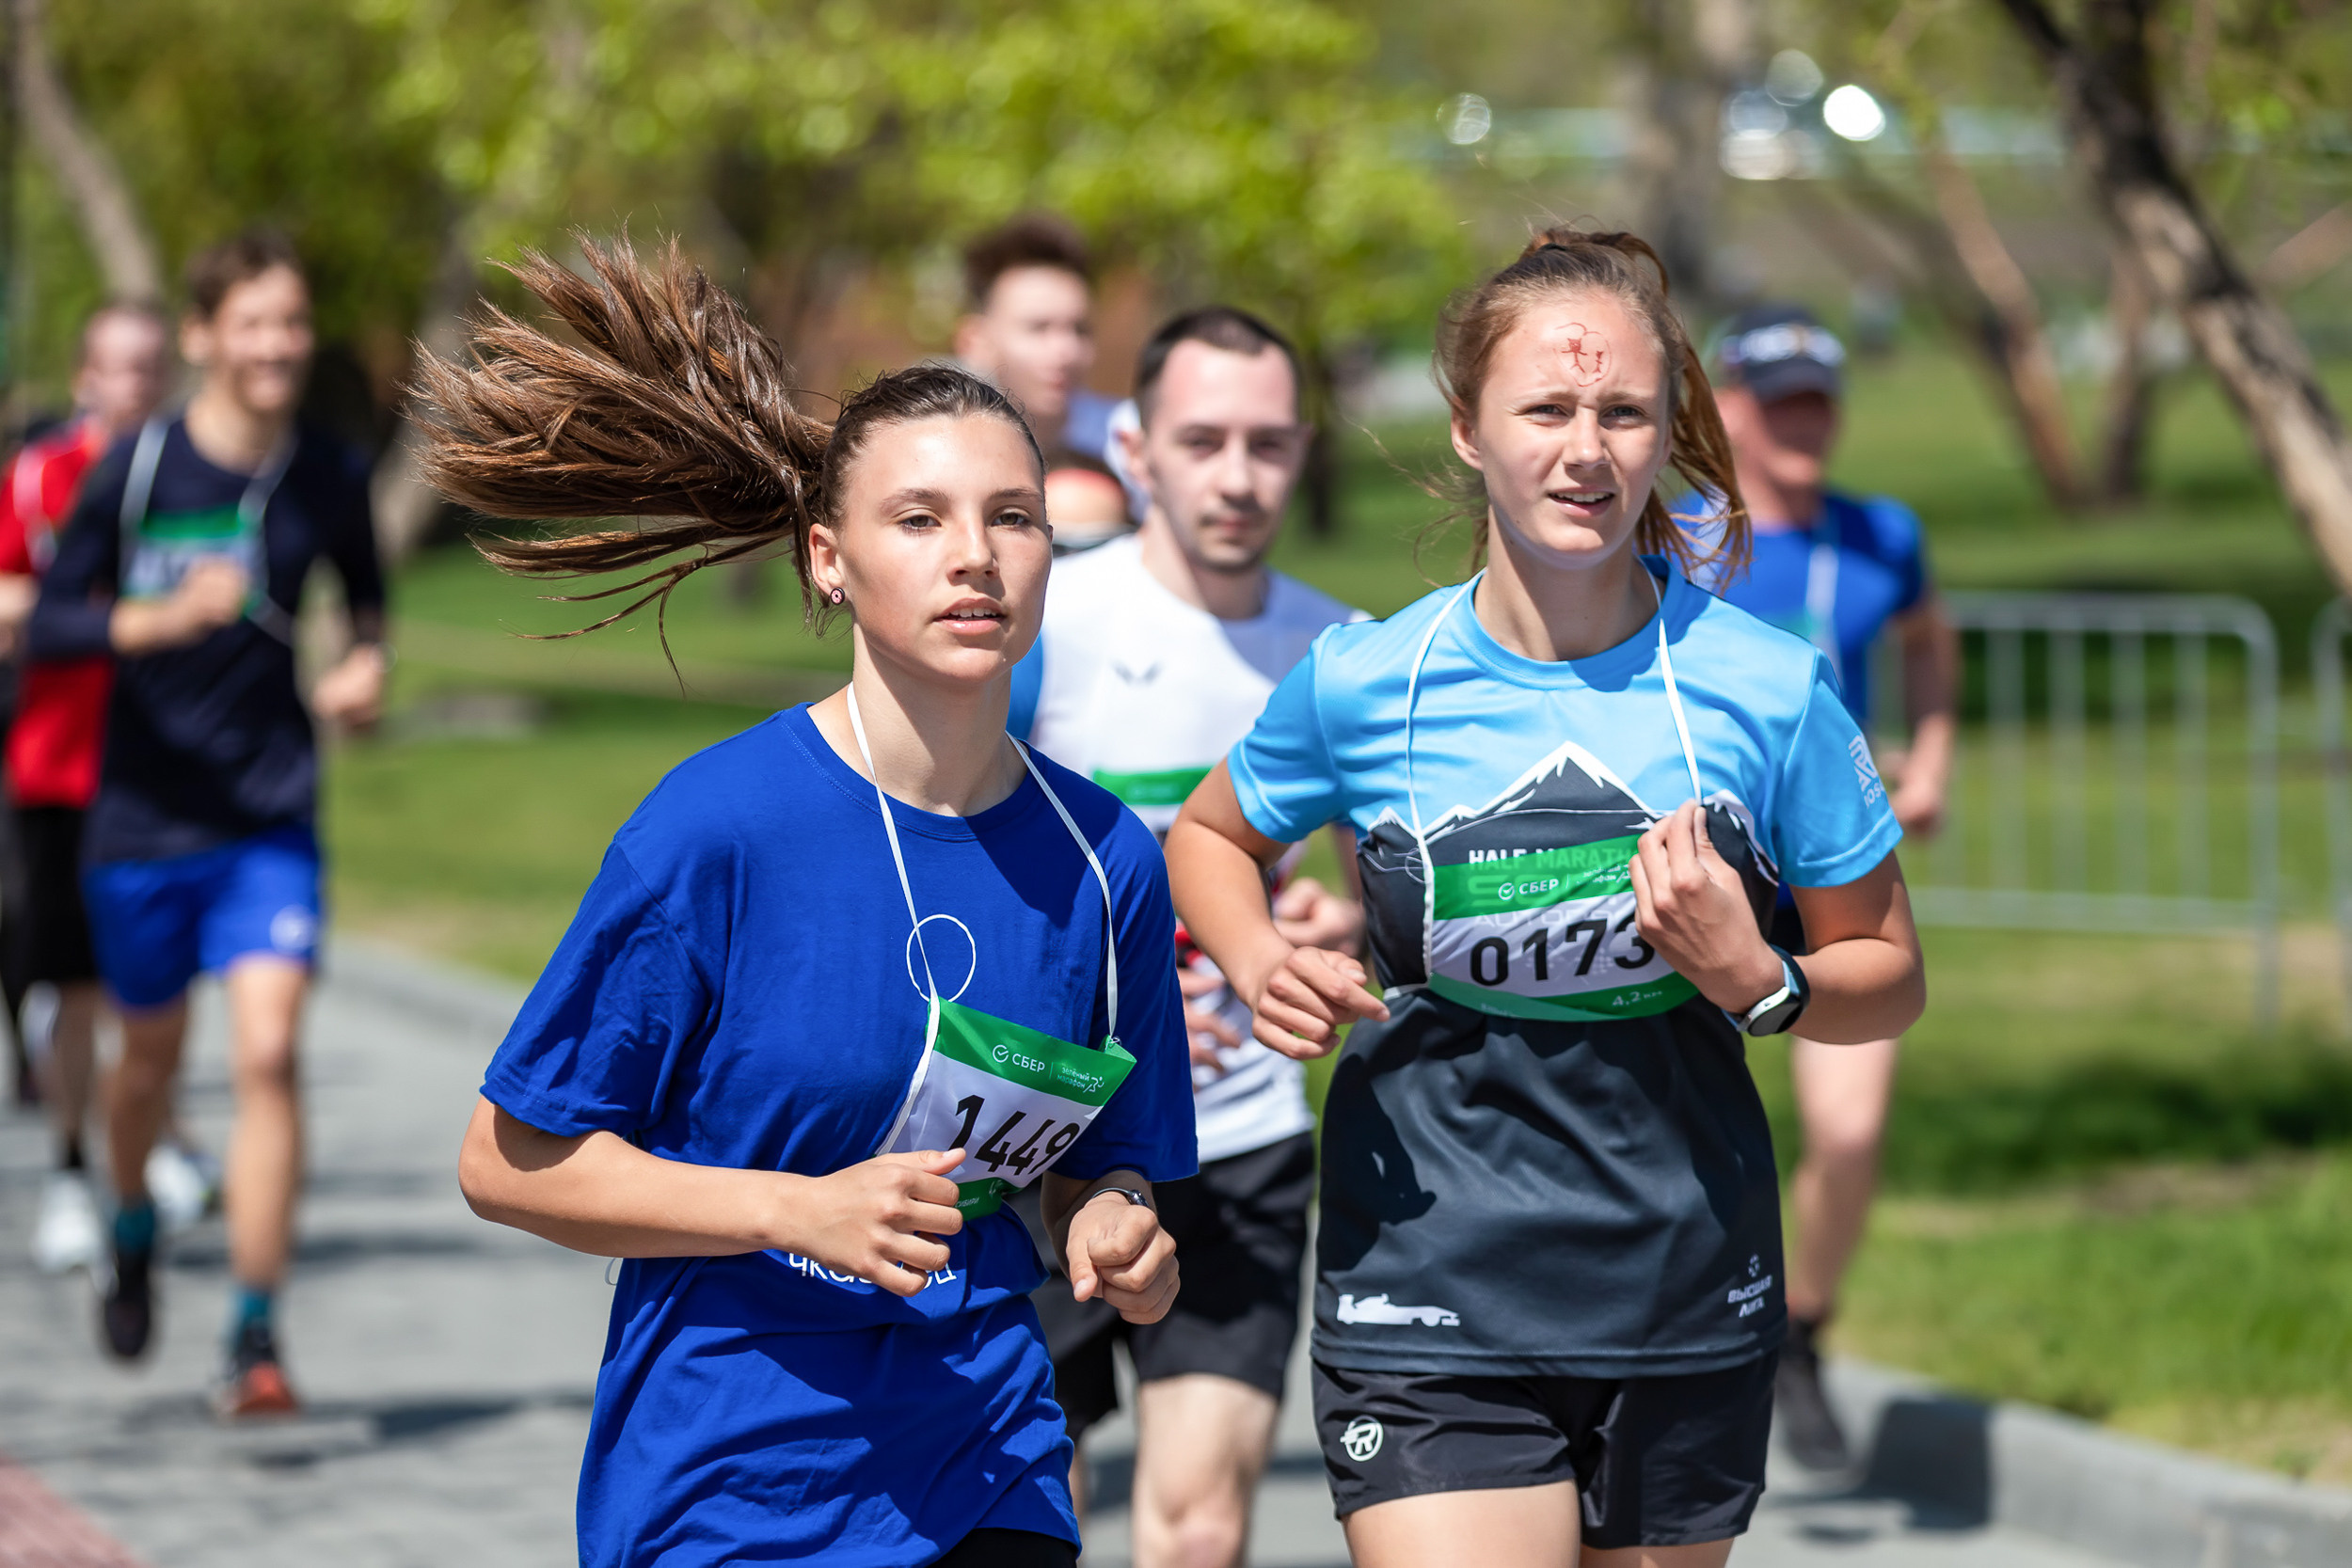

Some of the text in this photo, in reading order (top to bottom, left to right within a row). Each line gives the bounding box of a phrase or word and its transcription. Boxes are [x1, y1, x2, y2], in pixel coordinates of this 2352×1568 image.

[1518, 878, 1559, 895] СБЕР
[1469, 916, 1656, 988] 0173
[1011, 1053, 1046, 1073] СБЕР
[947, 1094, 1081, 1176] 1449
